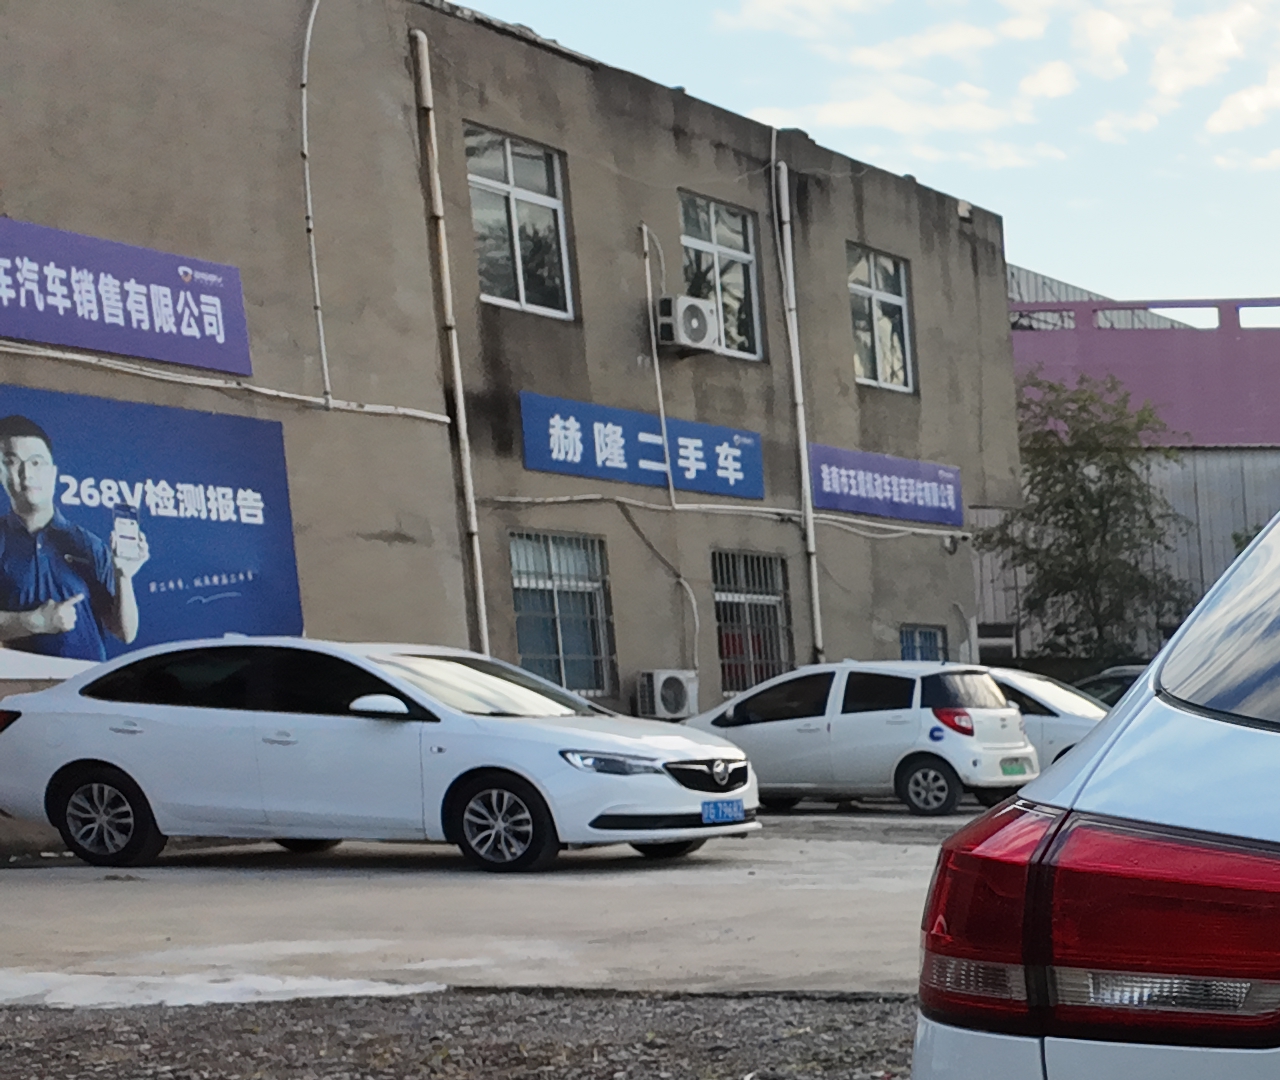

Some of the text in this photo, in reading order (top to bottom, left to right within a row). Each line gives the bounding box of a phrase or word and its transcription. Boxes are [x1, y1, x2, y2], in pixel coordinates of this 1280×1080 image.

[549, 413, 745, 486] 赫隆二手车
